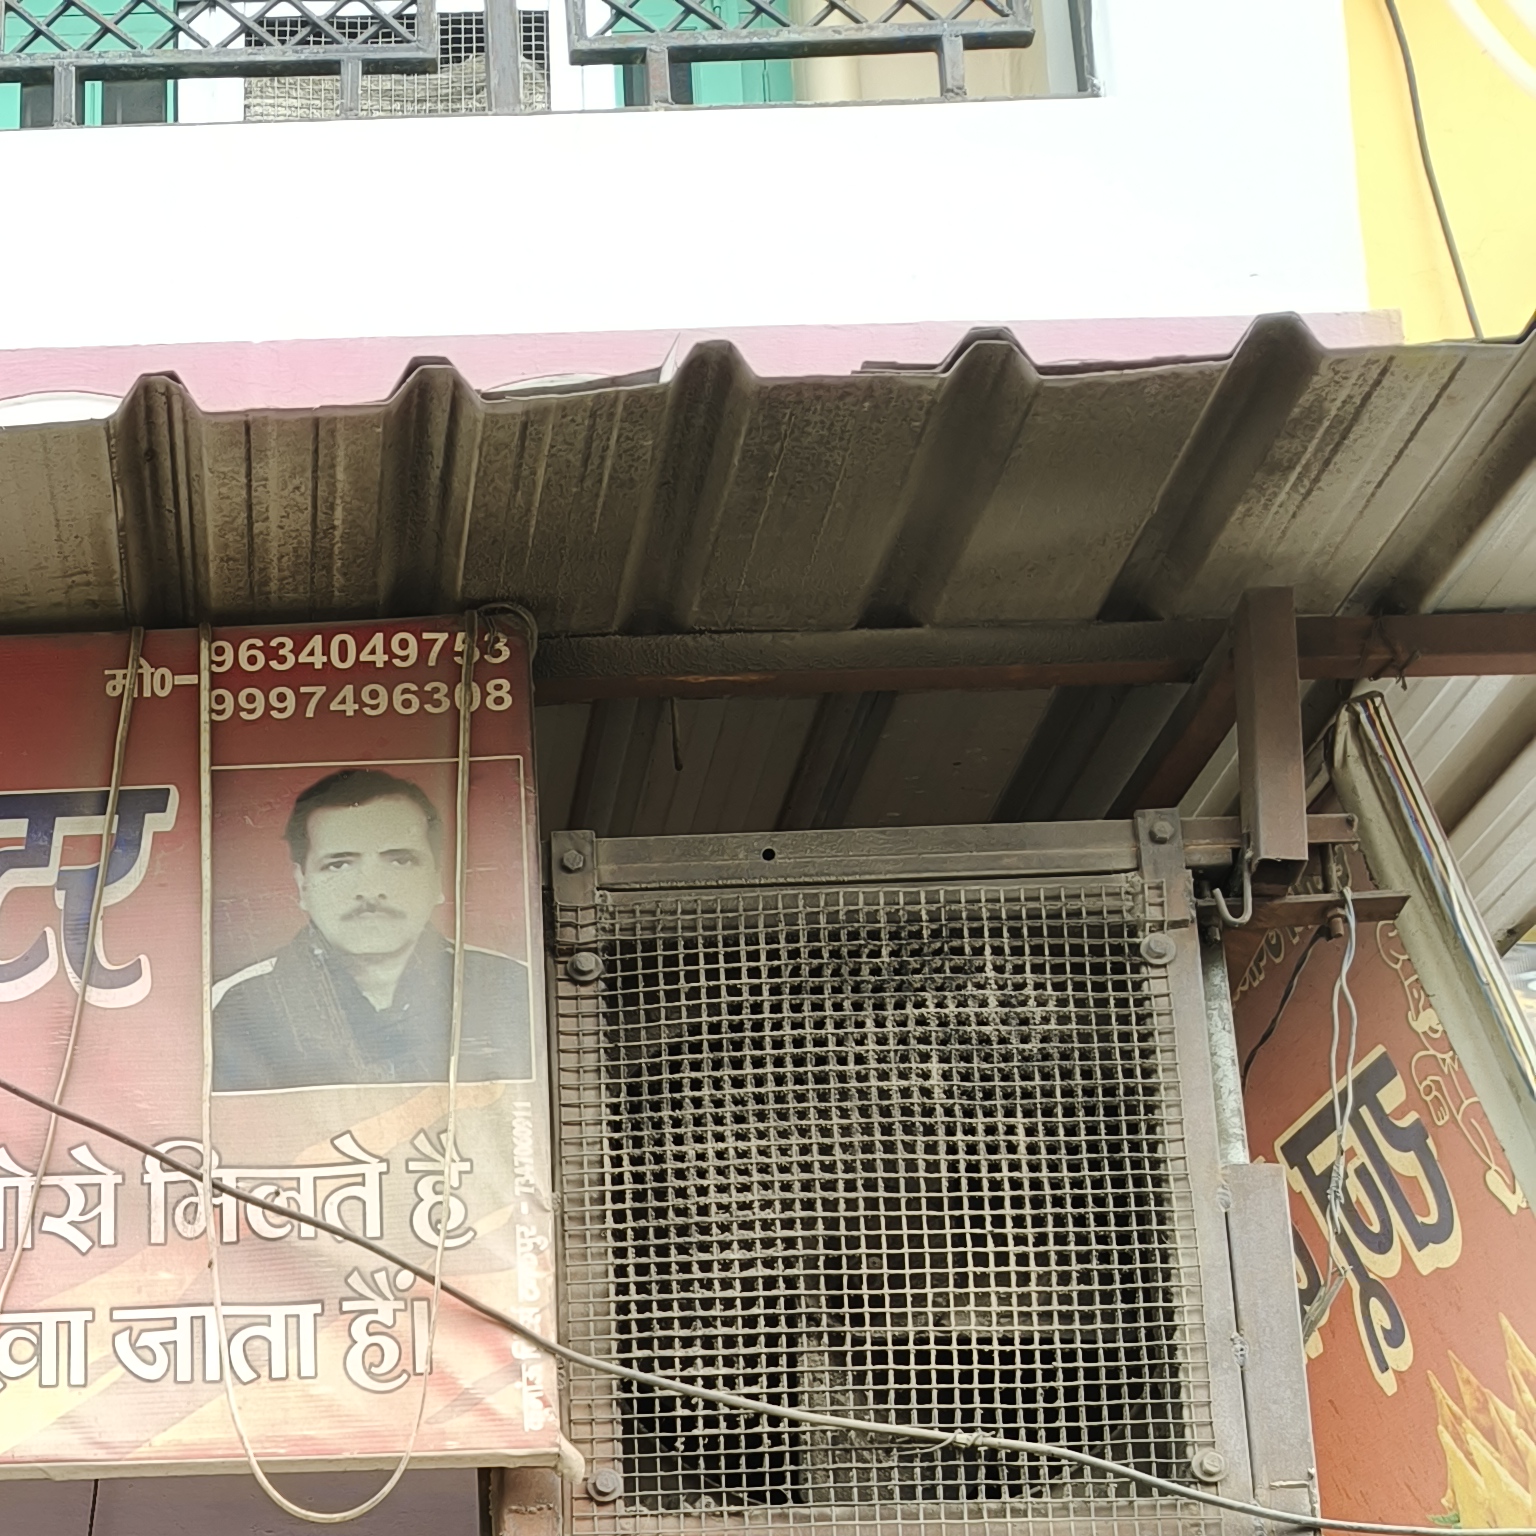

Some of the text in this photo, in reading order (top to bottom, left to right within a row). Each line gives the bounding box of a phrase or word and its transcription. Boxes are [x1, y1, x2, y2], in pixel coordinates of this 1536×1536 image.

[210, 630, 511, 673] 9634049753
[211, 678, 513, 722] 9997496308
[141, 1130, 390, 1246] मिलते
[110, 1300, 324, 1385] जाता
